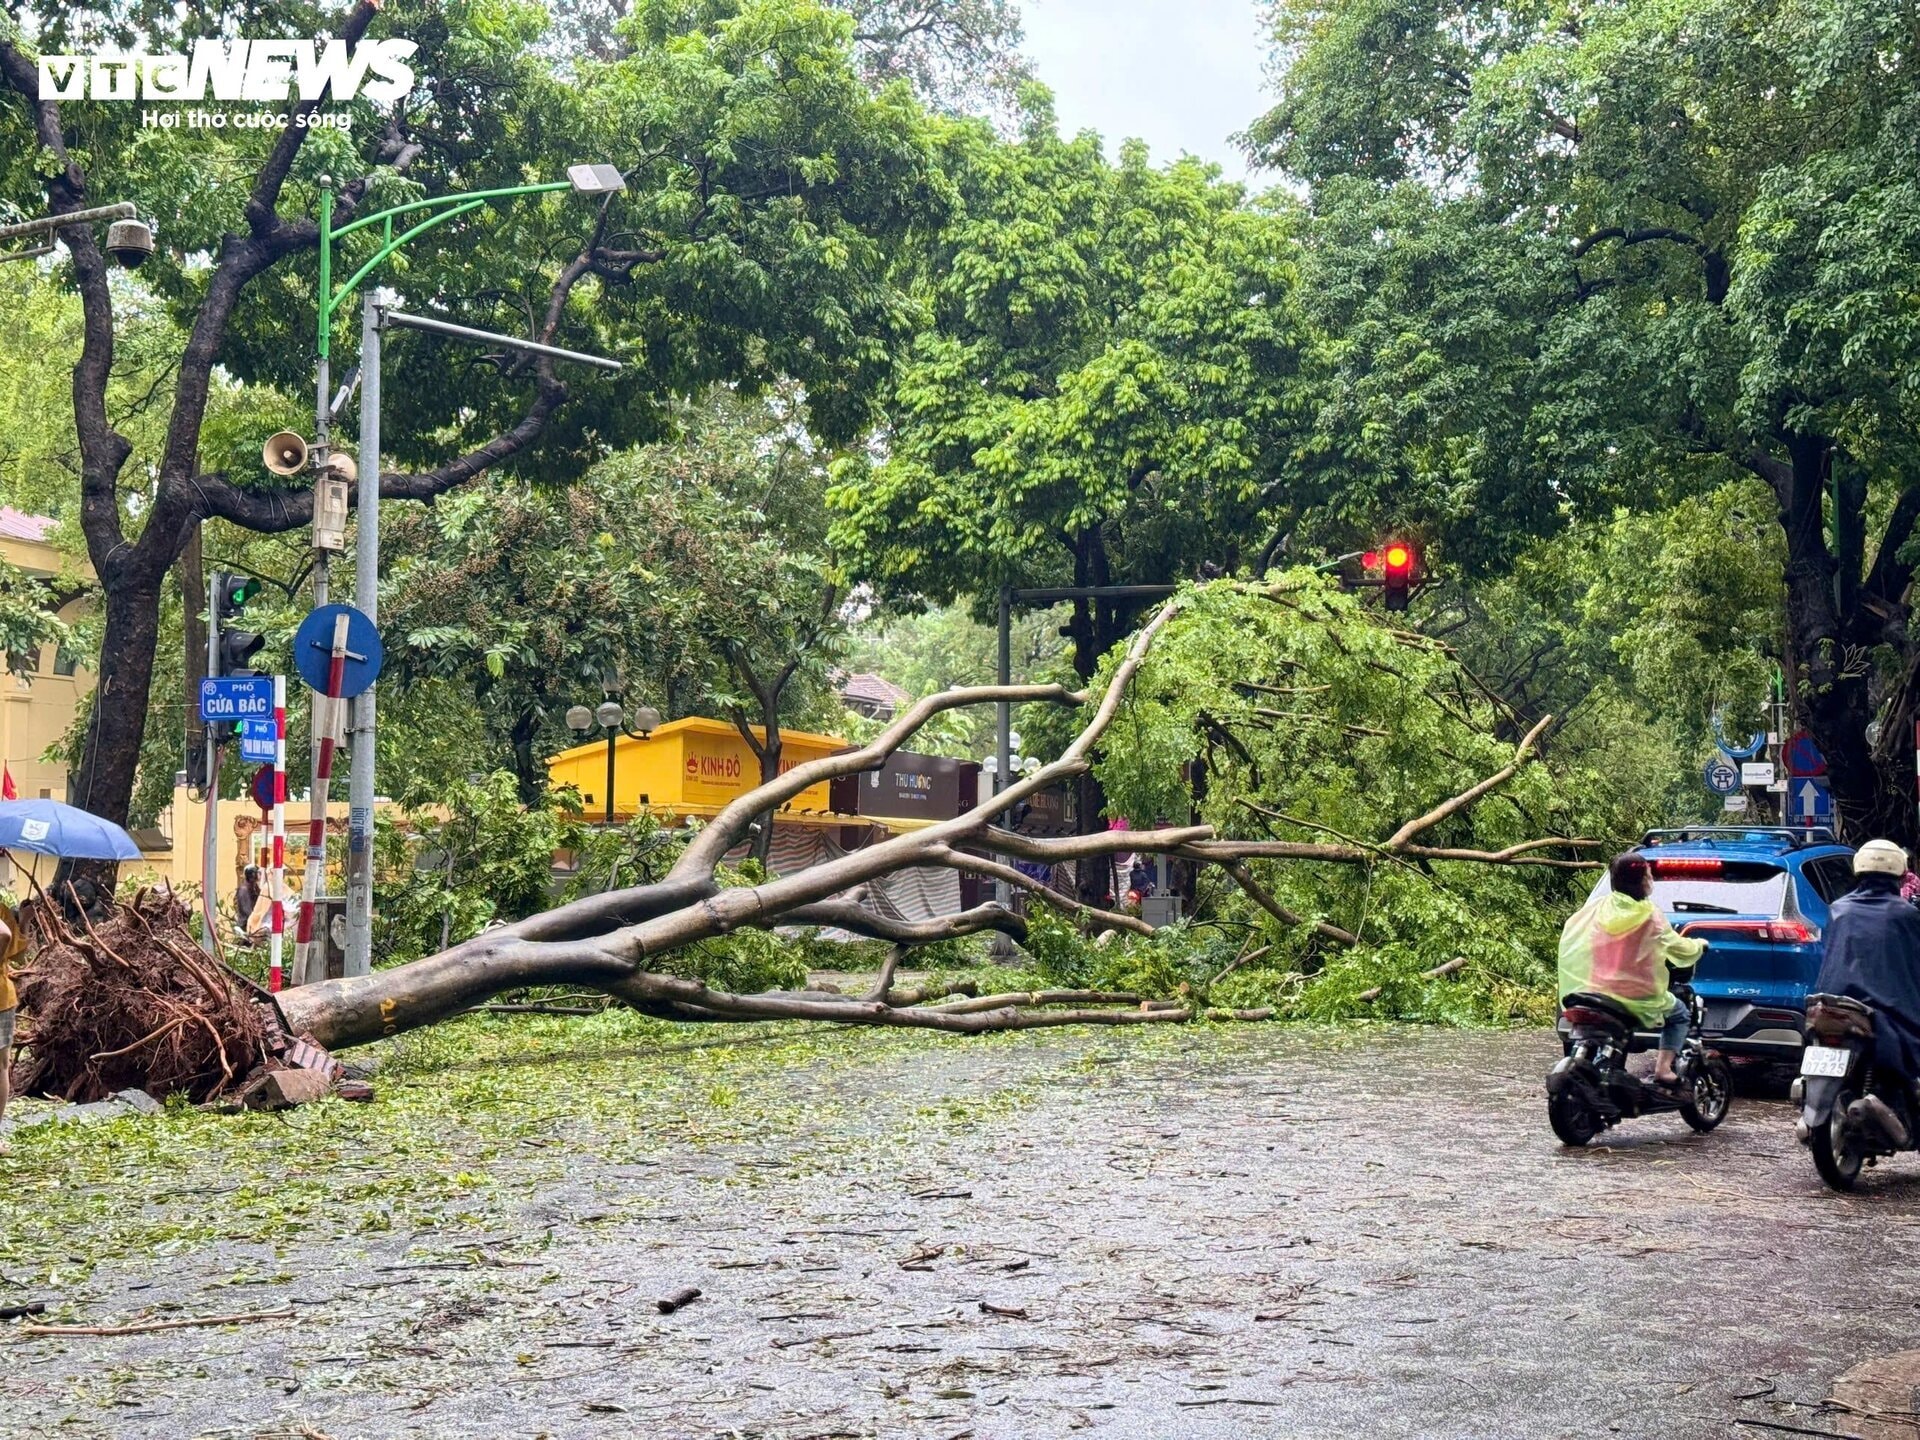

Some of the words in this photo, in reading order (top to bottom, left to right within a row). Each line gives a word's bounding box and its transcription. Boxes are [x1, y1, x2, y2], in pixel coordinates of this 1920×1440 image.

[232, 681, 255, 691] PHỐ
[207, 694, 234, 713] CỬA
[239, 694, 266, 712] BẮC
[701, 756, 724, 777] KINH
[726, 753, 741, 778] ĐÔ
[895, 772, 909, 788] THU
